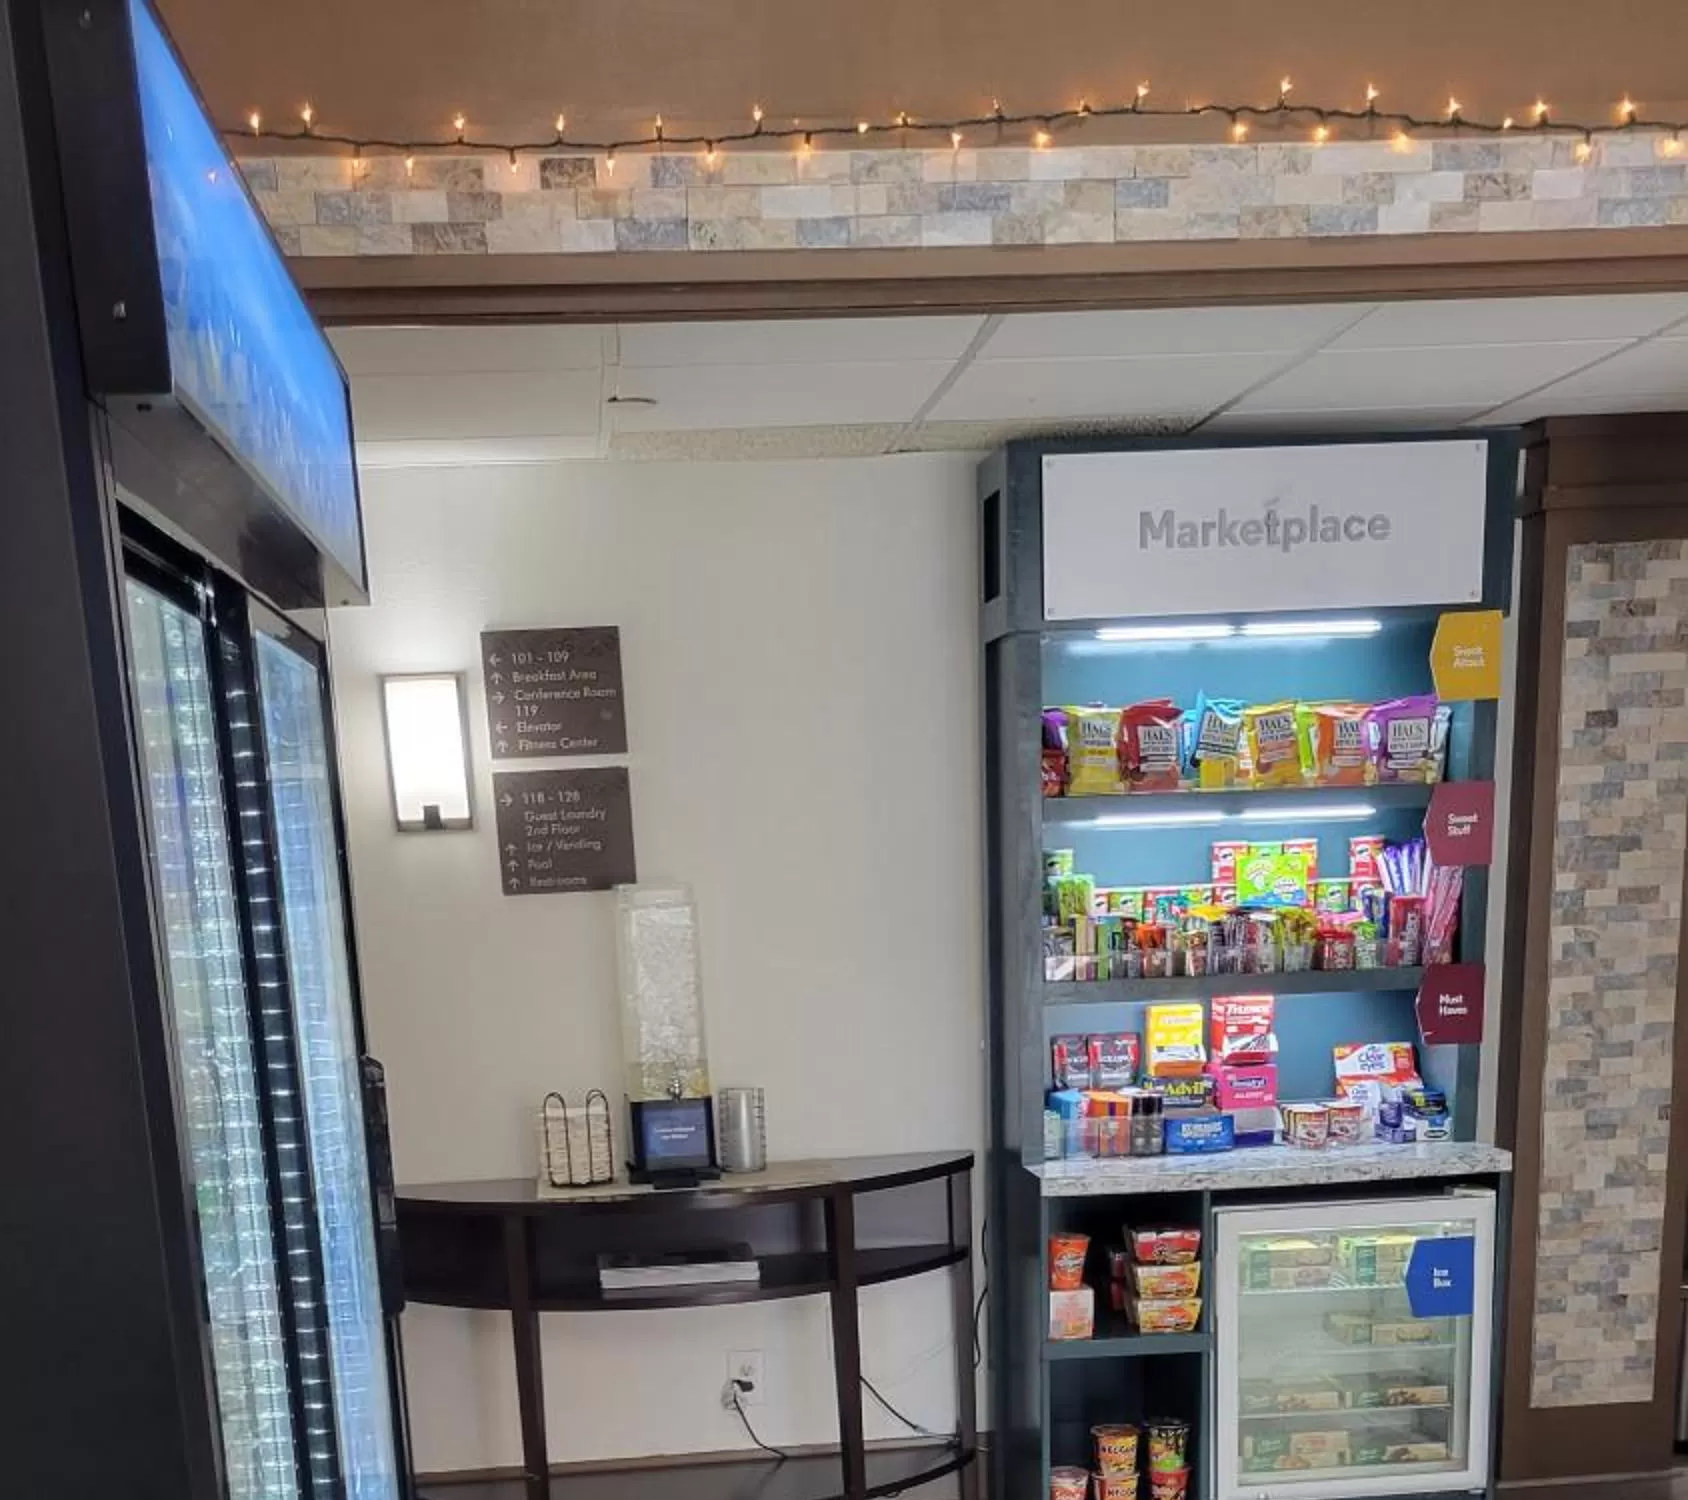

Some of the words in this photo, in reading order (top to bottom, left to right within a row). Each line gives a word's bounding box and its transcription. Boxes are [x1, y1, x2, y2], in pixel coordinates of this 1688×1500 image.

[1139, 502, 1392, 553] Marketplace
[512, 651, 533, 665] 101
[547, 650, 570, 664] 109
[512, 670, 566, 684] Breakfast
[569, 669, 597, 681] Area
[514, 687, 581, 701] Conference
[583, 685, 617, 698] Room
[515, 704, 539, 717] 119
[517, 720, 563, 733] Elevator
[519, 738, 557, 751] Fitness
[560, 737, 598, 749] Center
[524, 810, 558, 823] Guest
[560, 807, 607, 822] Laundry
[1448, 812, 1478, 824] Sweet
[524, 824, 549, 837] 2nd
[551, 822, 581, 835] Floor
[527, 841, 544, 853] Ice
[556, 838, 603, 852] Vending
[528, 858, 553, 870] Pool
[529, 876, 588, 888] Restrooms
[1440, 993, 1463, 1005] Must
